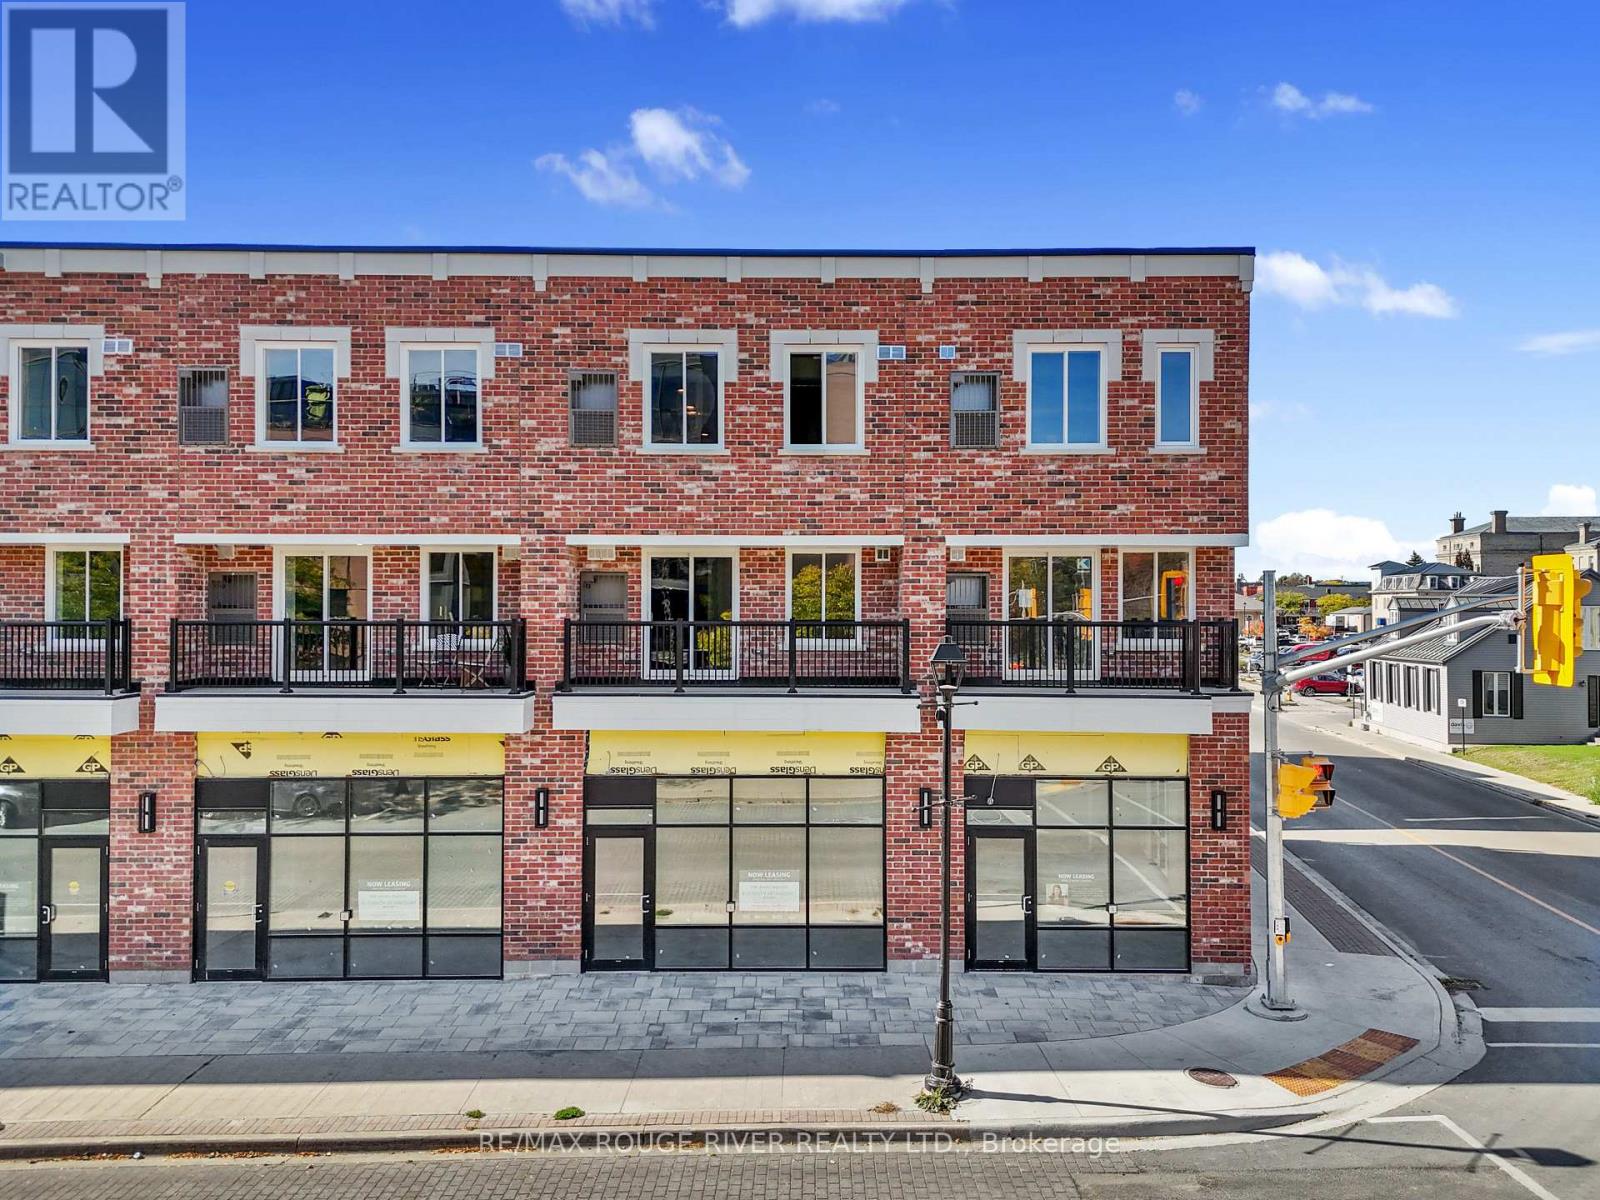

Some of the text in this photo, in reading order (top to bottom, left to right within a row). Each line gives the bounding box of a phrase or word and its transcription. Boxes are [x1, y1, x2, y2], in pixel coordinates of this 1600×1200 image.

[0, 763, 18, 772] GP
[82, 763, 101, 772] GP
[965, 761, 983, 770] GP
[1020, 761, 1039, 770] GP
[1102, 762, 1120, 771] GP
[610, 767, 657, 775] DensGlass
[690, 767, 737, 775] DensGlass
[770, 766, 817, 775] DensGlass
